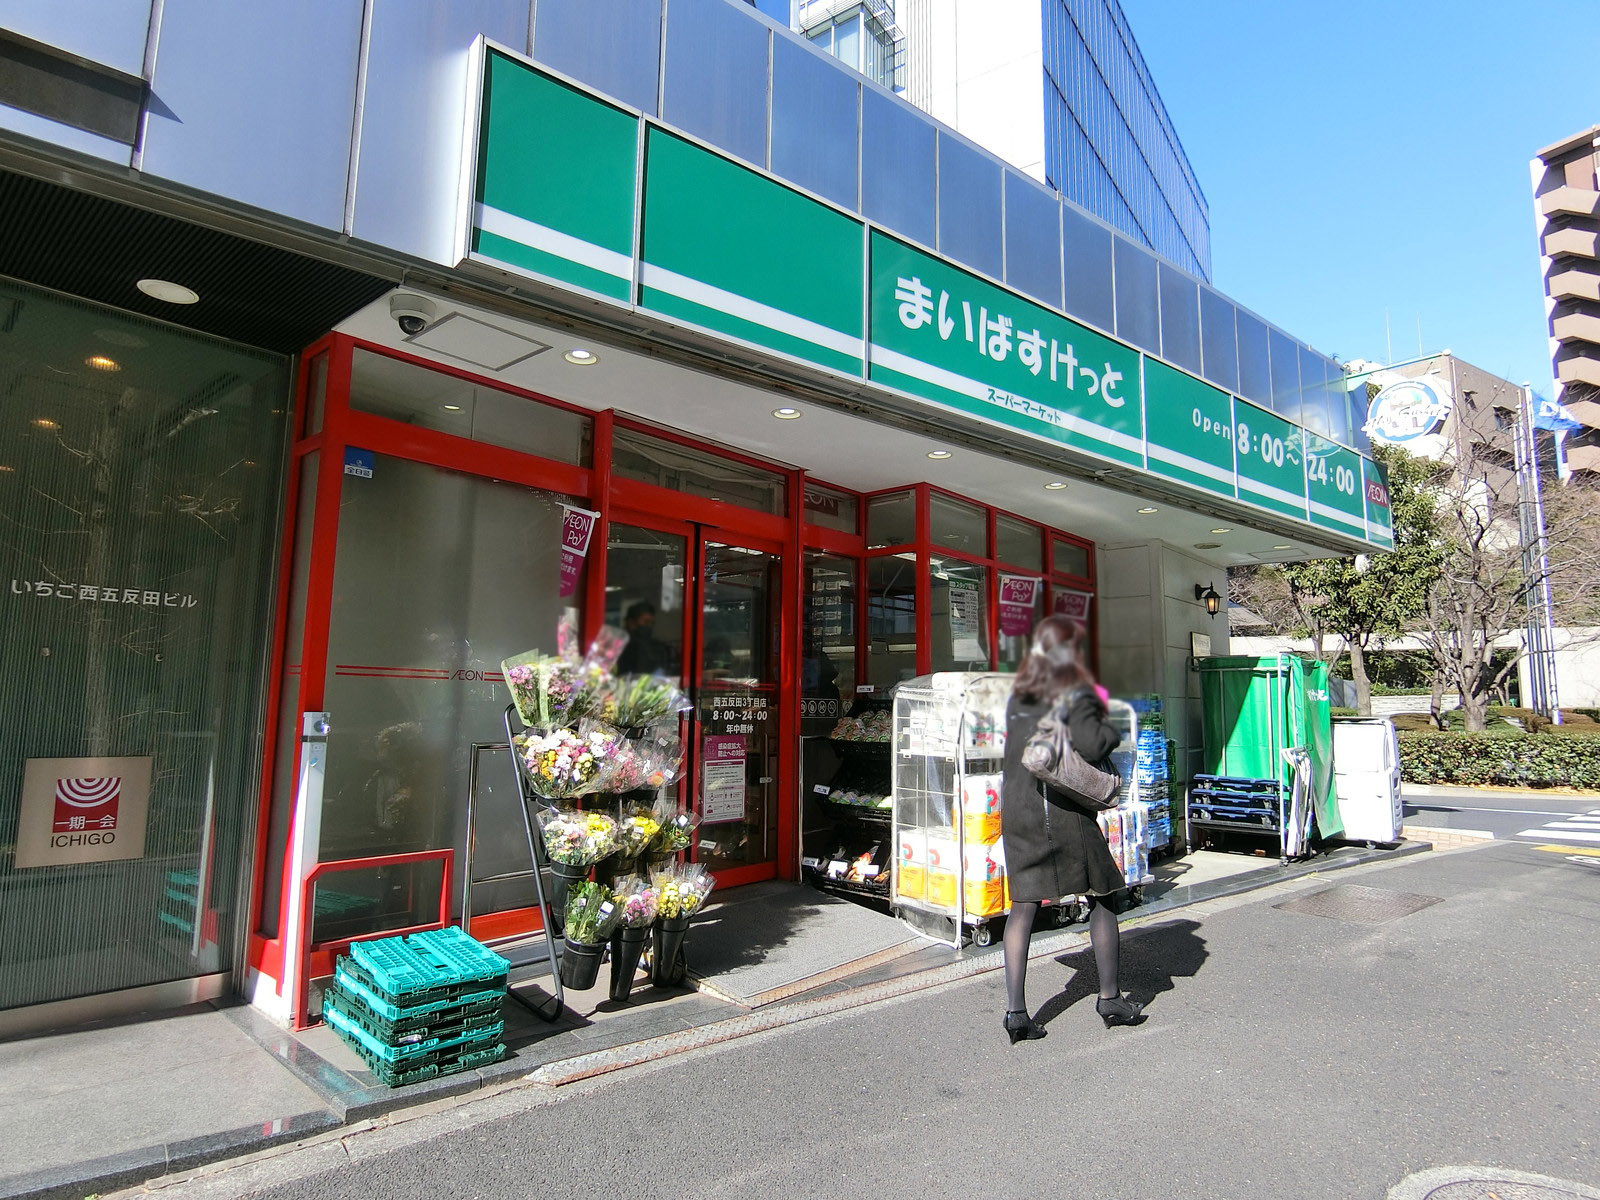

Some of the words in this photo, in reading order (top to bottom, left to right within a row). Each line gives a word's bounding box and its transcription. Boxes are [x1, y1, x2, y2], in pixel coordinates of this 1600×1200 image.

[894, 276, 1126, 408] まいばすけっと
[987, 388, 1062, 423] スーパーマーケット
[1192, 408, 1231, 440] Open
[567, 531, 586, 546] Pay
[11, 579, 198, 608] いちご西五反田ビル
[1012, 592, 1030, 601] Pay
[713, 697, 767, 708] 西五反田3丁目店
[726, 724, 754, 734] 年中無休
[55, 814, 116, 830] 一期一会
[50, 832, 116, 848] ICHIGO
